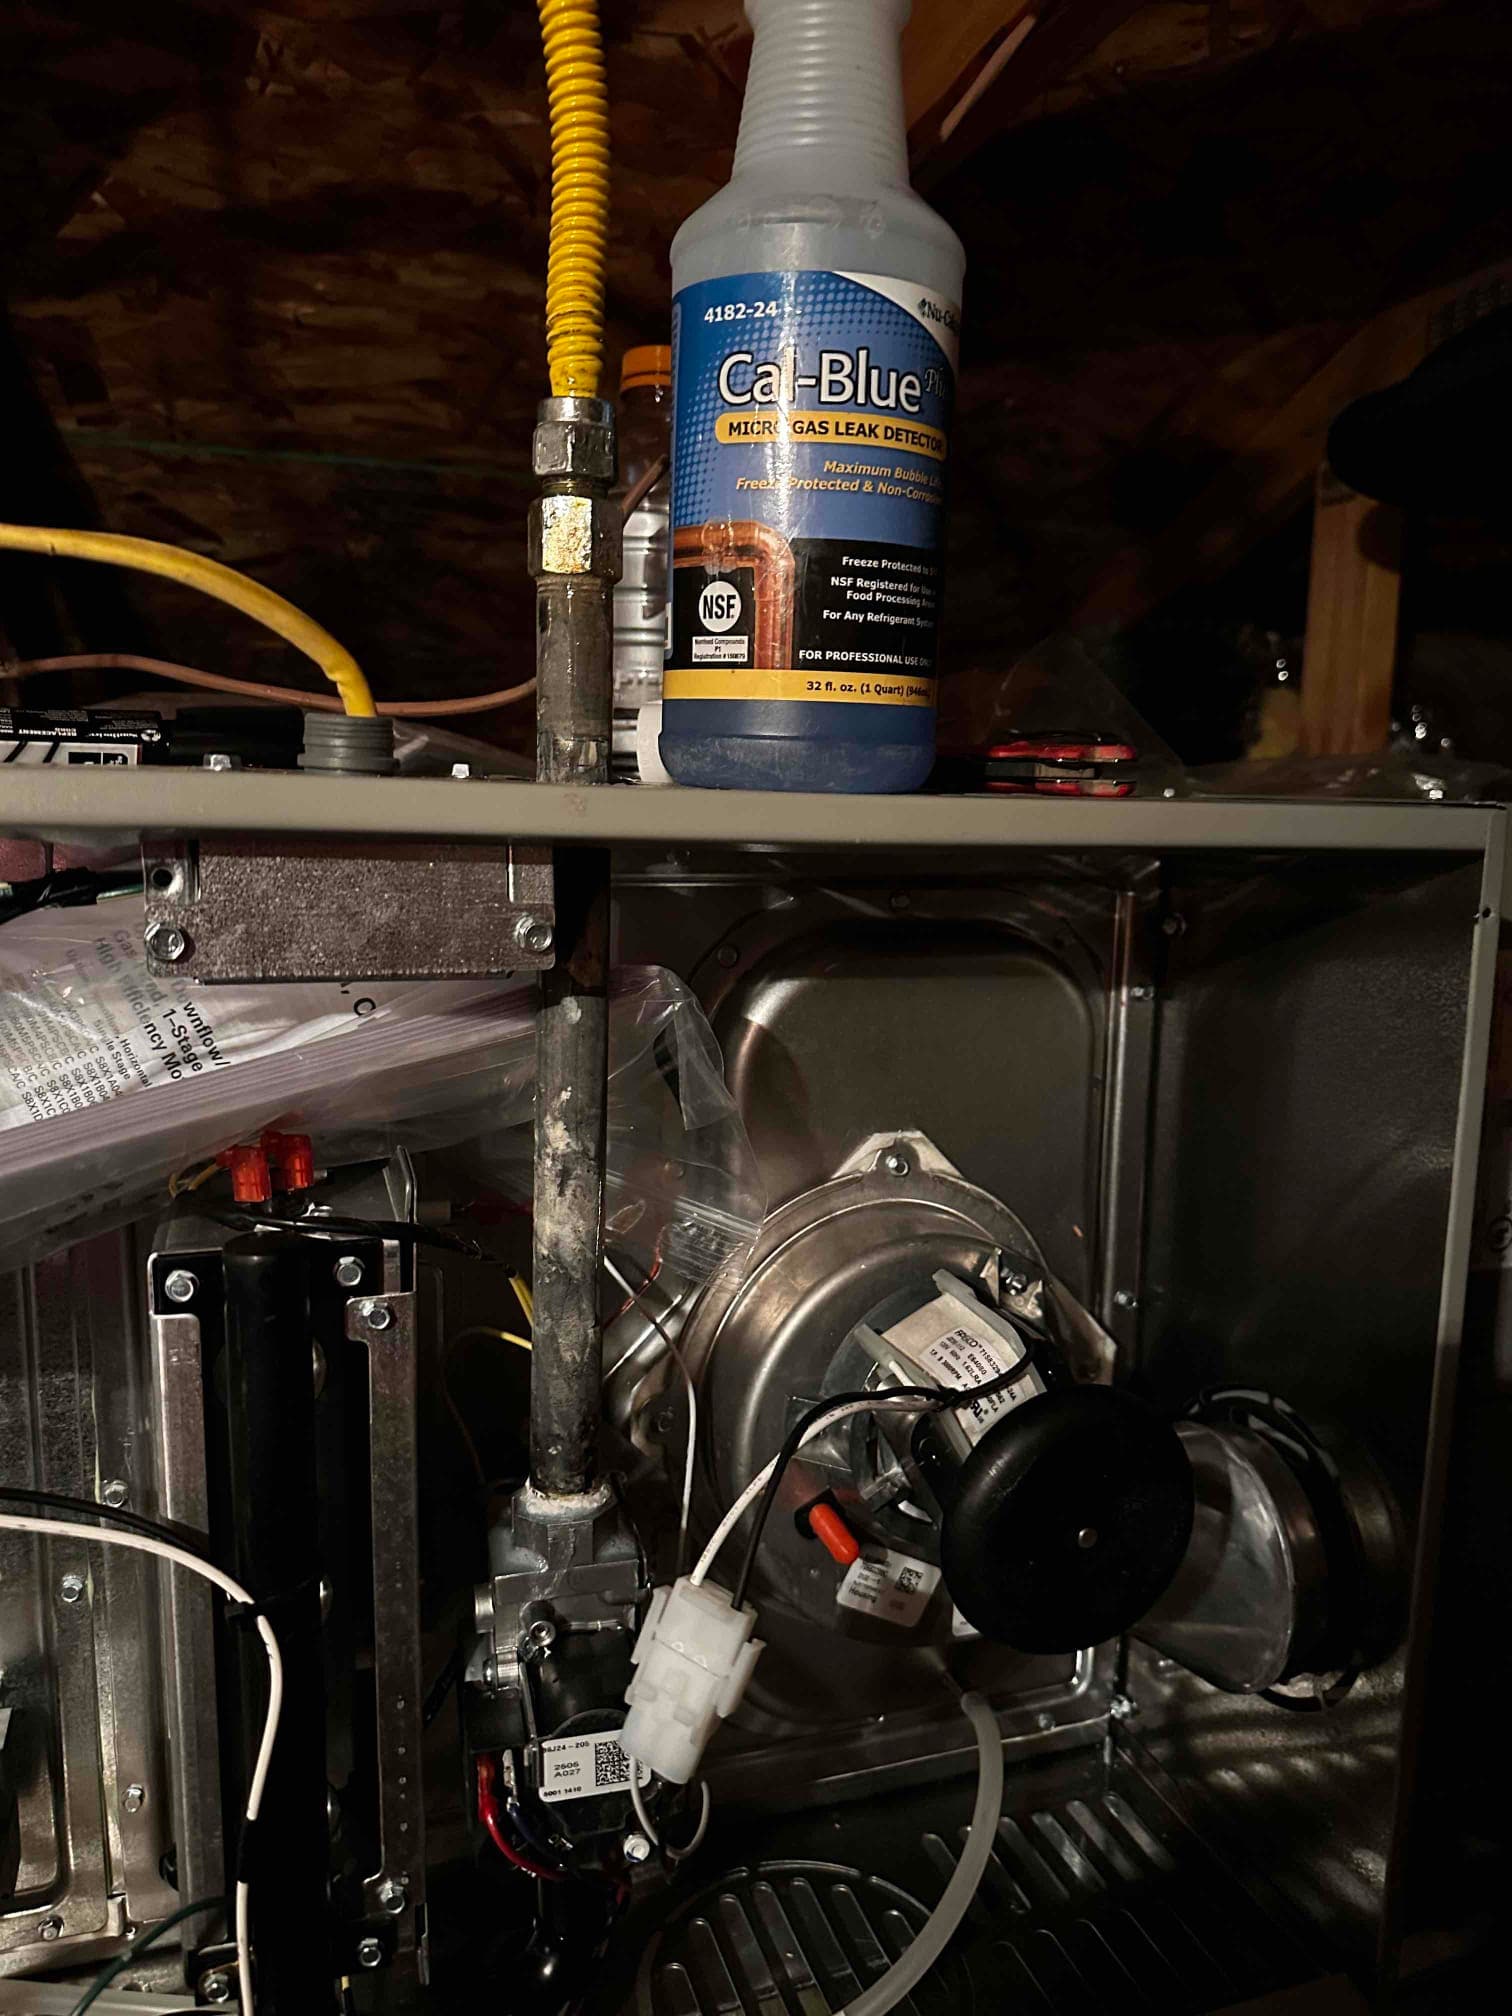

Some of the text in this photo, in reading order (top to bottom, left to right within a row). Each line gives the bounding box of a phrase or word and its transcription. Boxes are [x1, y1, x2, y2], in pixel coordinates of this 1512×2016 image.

[703, 301, 778, 323] 4182-24
[718, 346, 923, 414] Cal-Blue
[728, 420, 784, 437] MICR
[792, 419, 829, 436] GAS
[835, 420, 880, 439] LEAK
[823, 460, 892, 478] Maximum
[894, 467, 929, 485] Bubble
[788, 477, 860, 491] Protected
[862, 480, 875, 493] &
[842, 556, 879, 568] Freeze
[881, 559, 921, 574] Protected
[830, 576, 854, 588] NSF
[856, 577, 908, 592] Registered
[910, 582, 920, 593] for
[703, 594, 737, 619] NSF
[846, 590, 873, 602] Food
[875, 592, 920, 608] Processing
[822, 609, 841, 621] For
[844, 611, 865, 623] Any
[867, 612, 915, 625] Refrigerant
[798, 650, 823, 660] FOR
[825, 650, 904, 665] PROFESSIONAL
[904, 656, 918, 666] USE
[806, 681, 822, 691] 32
[825, 681, 837, 692] fl.
[840, 683, 857, 693] oz.
[861, 683, 871, 695] (1
[874, 684, 904, 697] Quart)
[112, 1051, 131, 1081] Stage
[120, 1038, 152, 1088] Horizontal
[162, 1052, 184, 1081] Mo
[22, 1091, 44, 1121] S8X1D
[34, 1085, 57, 1116] S8X1C
